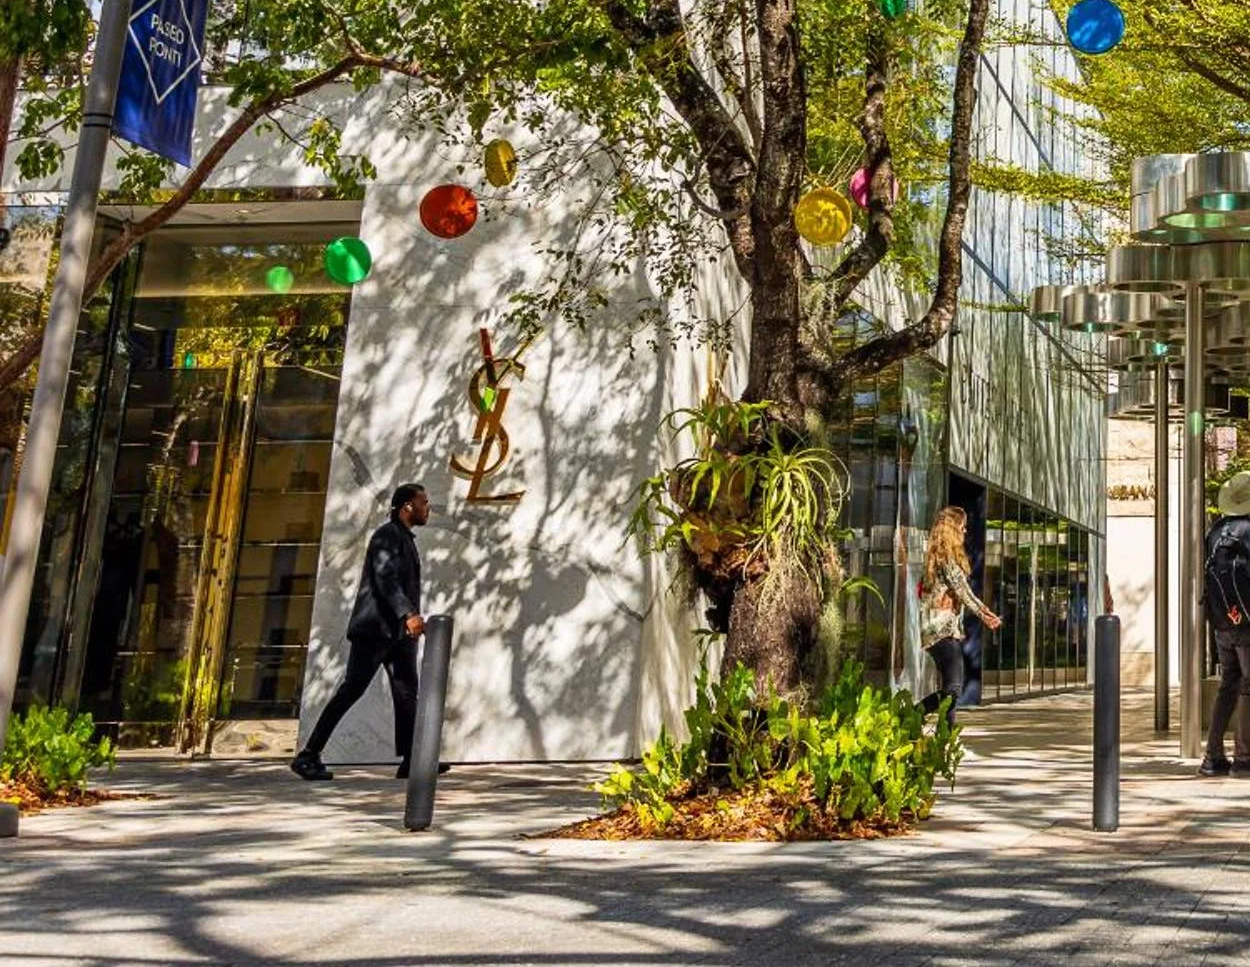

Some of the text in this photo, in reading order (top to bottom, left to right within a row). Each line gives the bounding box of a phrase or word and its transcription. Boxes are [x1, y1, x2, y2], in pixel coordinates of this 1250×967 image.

[151, 13, 184, 45] PASEO
[149, 36, 182, 68] PONTI
[449, 327, 541, 502] YSL
